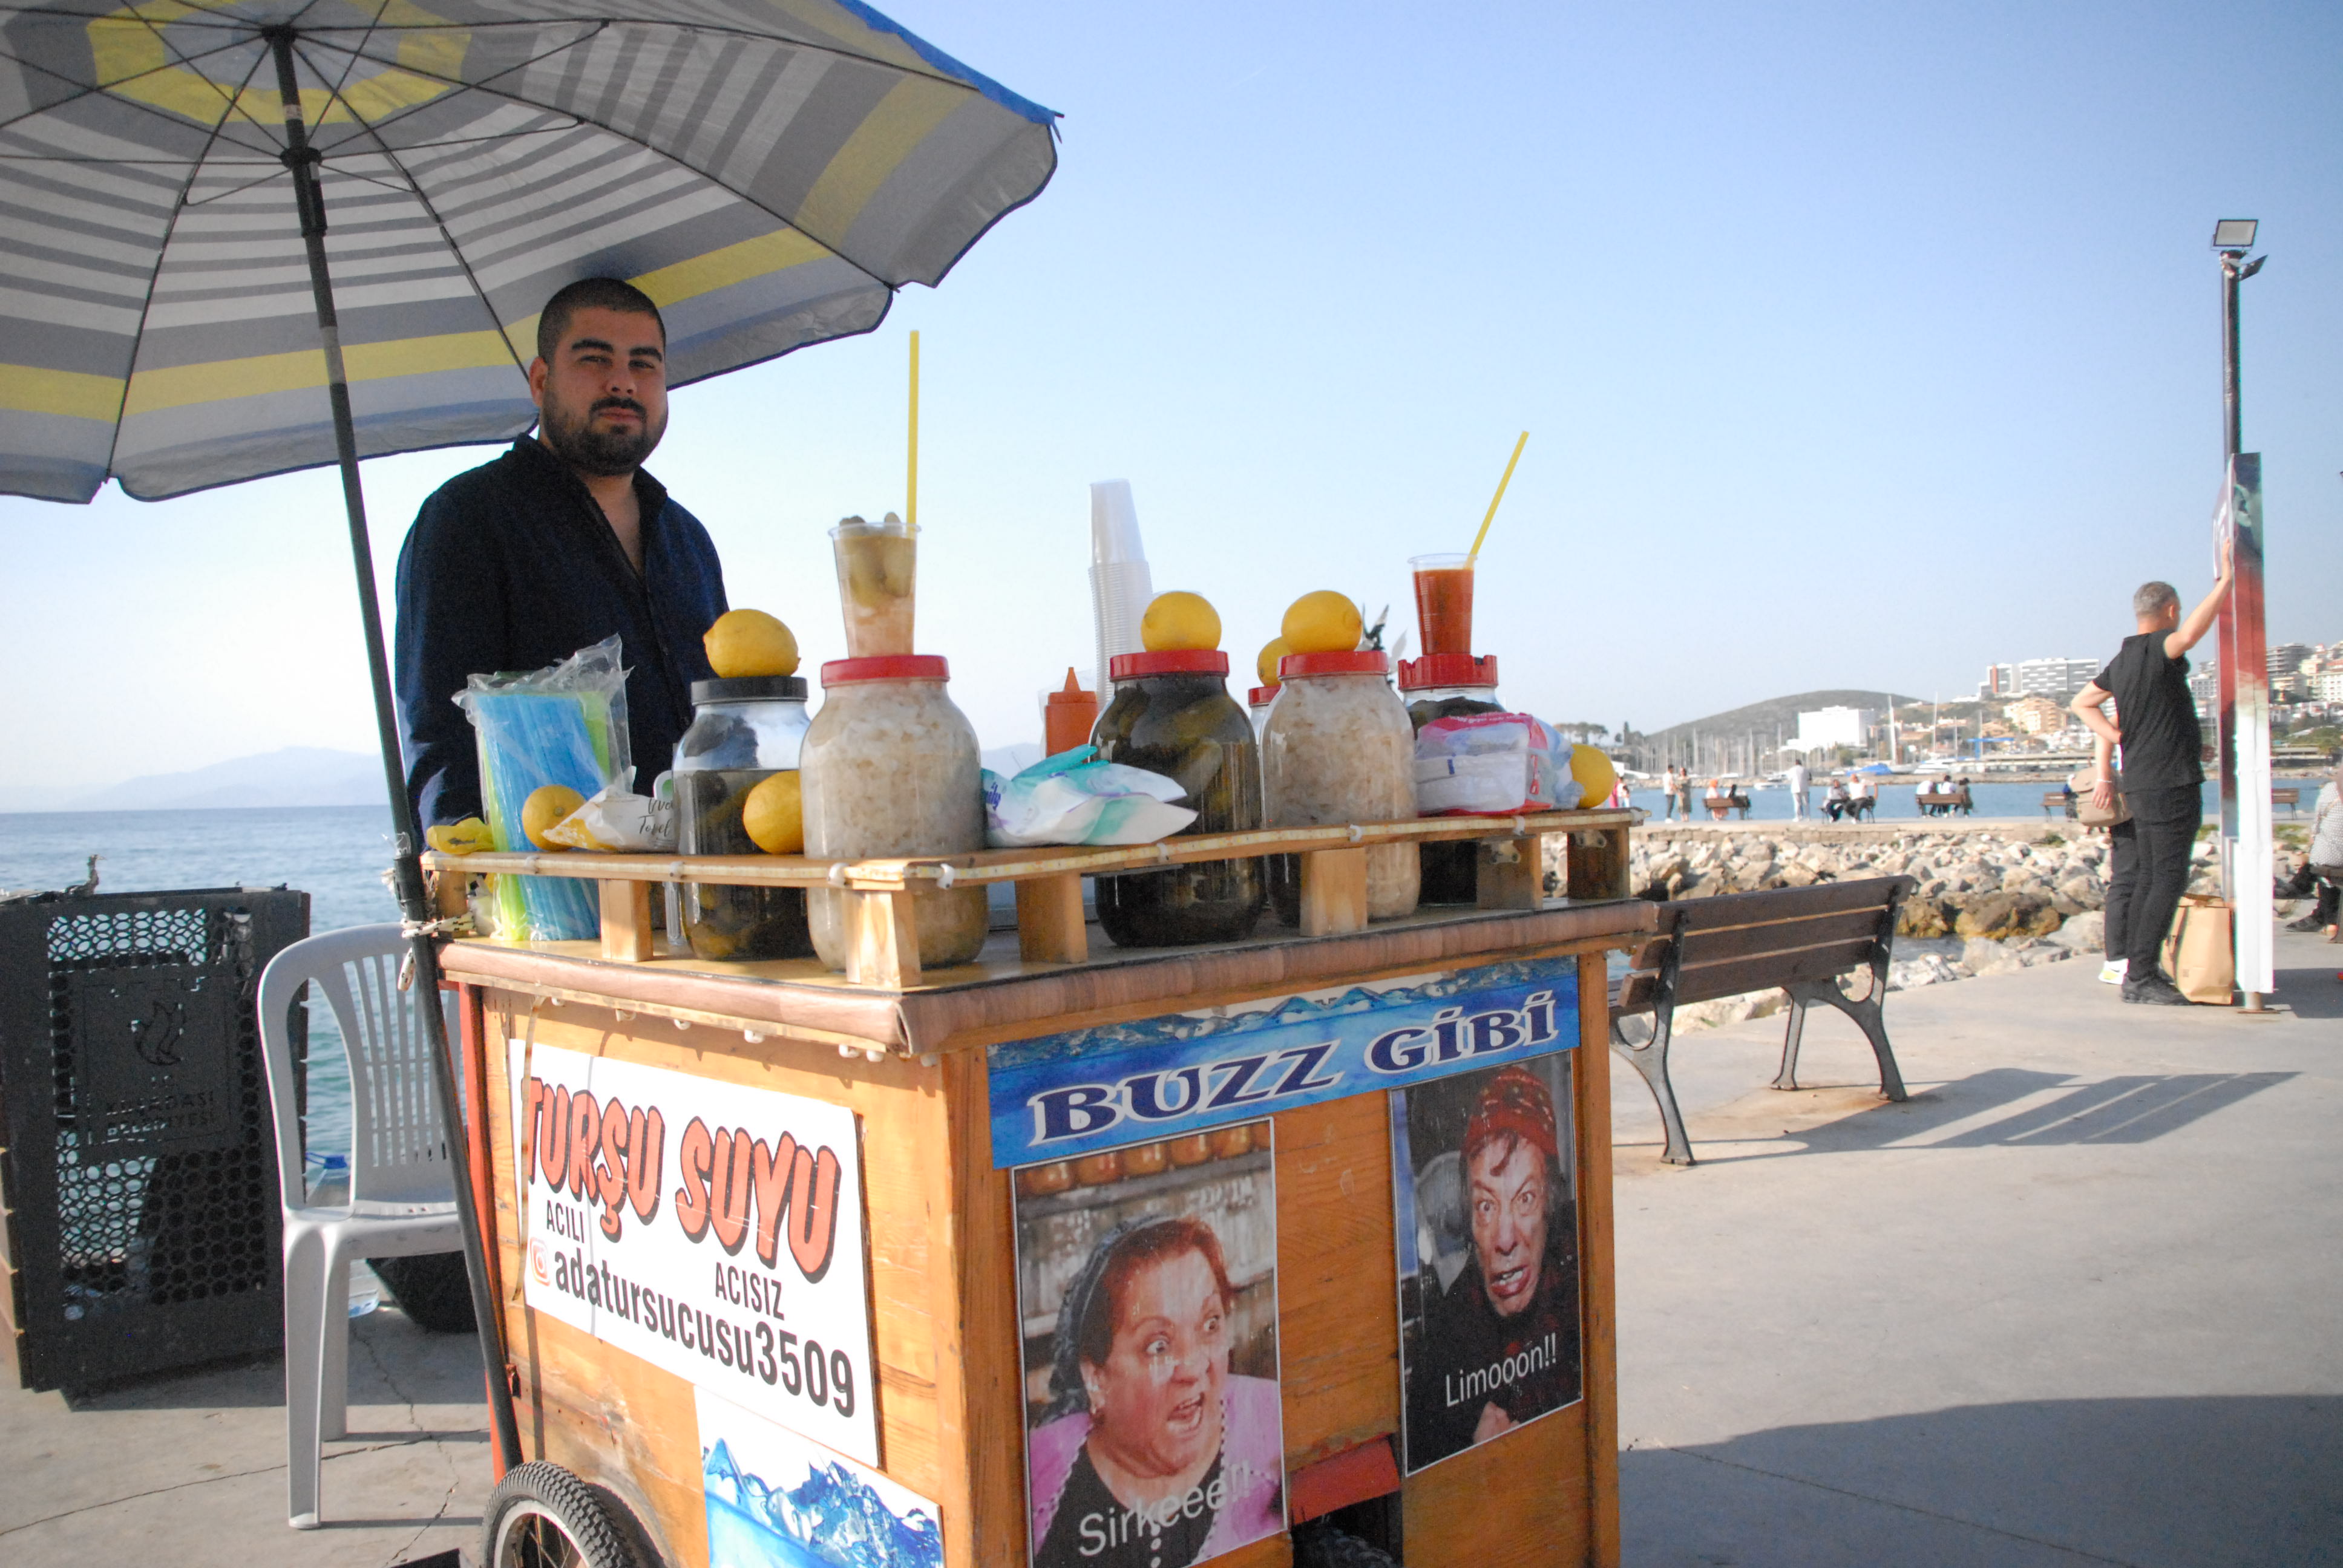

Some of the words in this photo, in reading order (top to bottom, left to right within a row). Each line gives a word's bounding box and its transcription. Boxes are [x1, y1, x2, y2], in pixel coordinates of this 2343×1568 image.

[1027, 1039, 1345, 1147] BUZZ
[1363, 989, 1559, 1075] GİBİ
[521, 1076, 665, 1243] TURŞU
[675, 1116, 842, 1284] SUYU
[546, 1200, 585, 1243] ACILI
[554, 1247, 855, 1419] adatursucusu3509
[715, 1263, 785, 1321] ACISIZ
[1446, 1333, 1556, 1407] Limooon!!
[1080, 1460, 1251, 1557] Sirkeee!!
